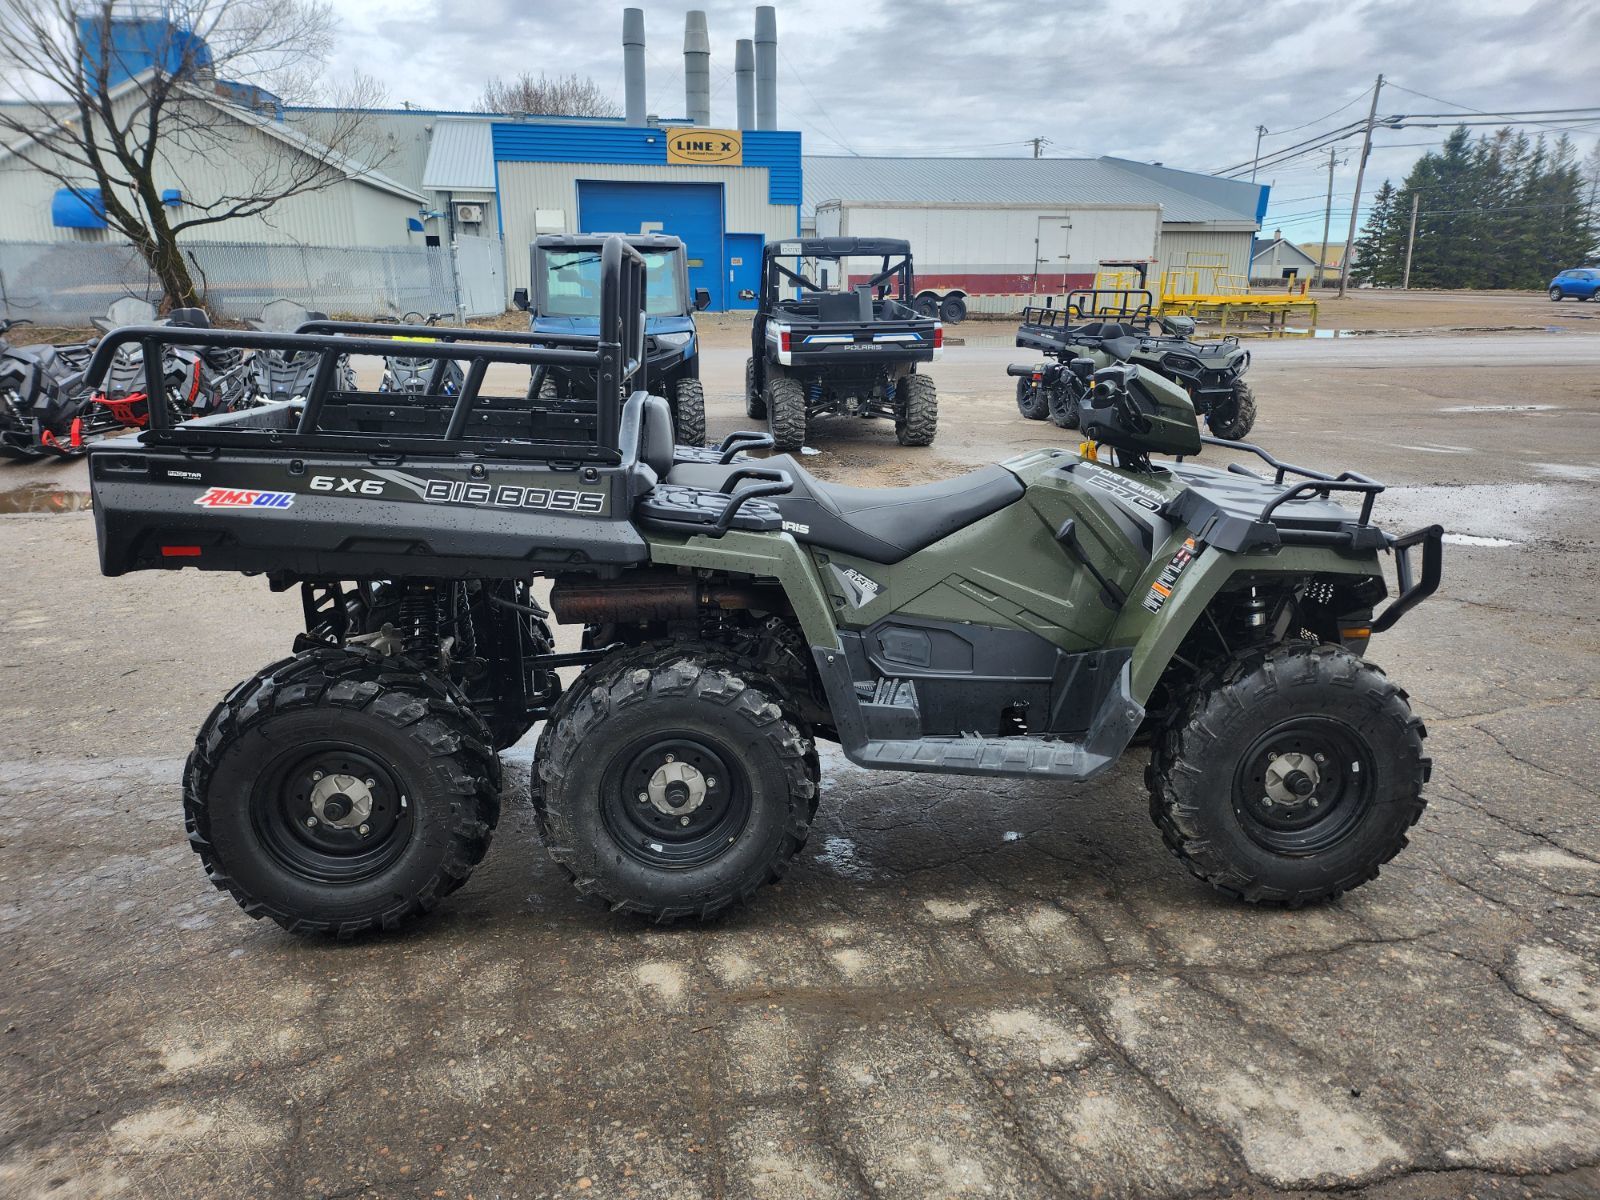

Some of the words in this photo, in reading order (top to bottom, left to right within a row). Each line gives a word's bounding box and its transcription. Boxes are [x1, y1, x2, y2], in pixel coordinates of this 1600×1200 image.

[196, 487, 294, 508] AMSOIL
[423, 479, 491, 503] BIG
[494, 485, 606, 513] BOSS
[1080, 461, 1170, 503] SPORTSMAN
